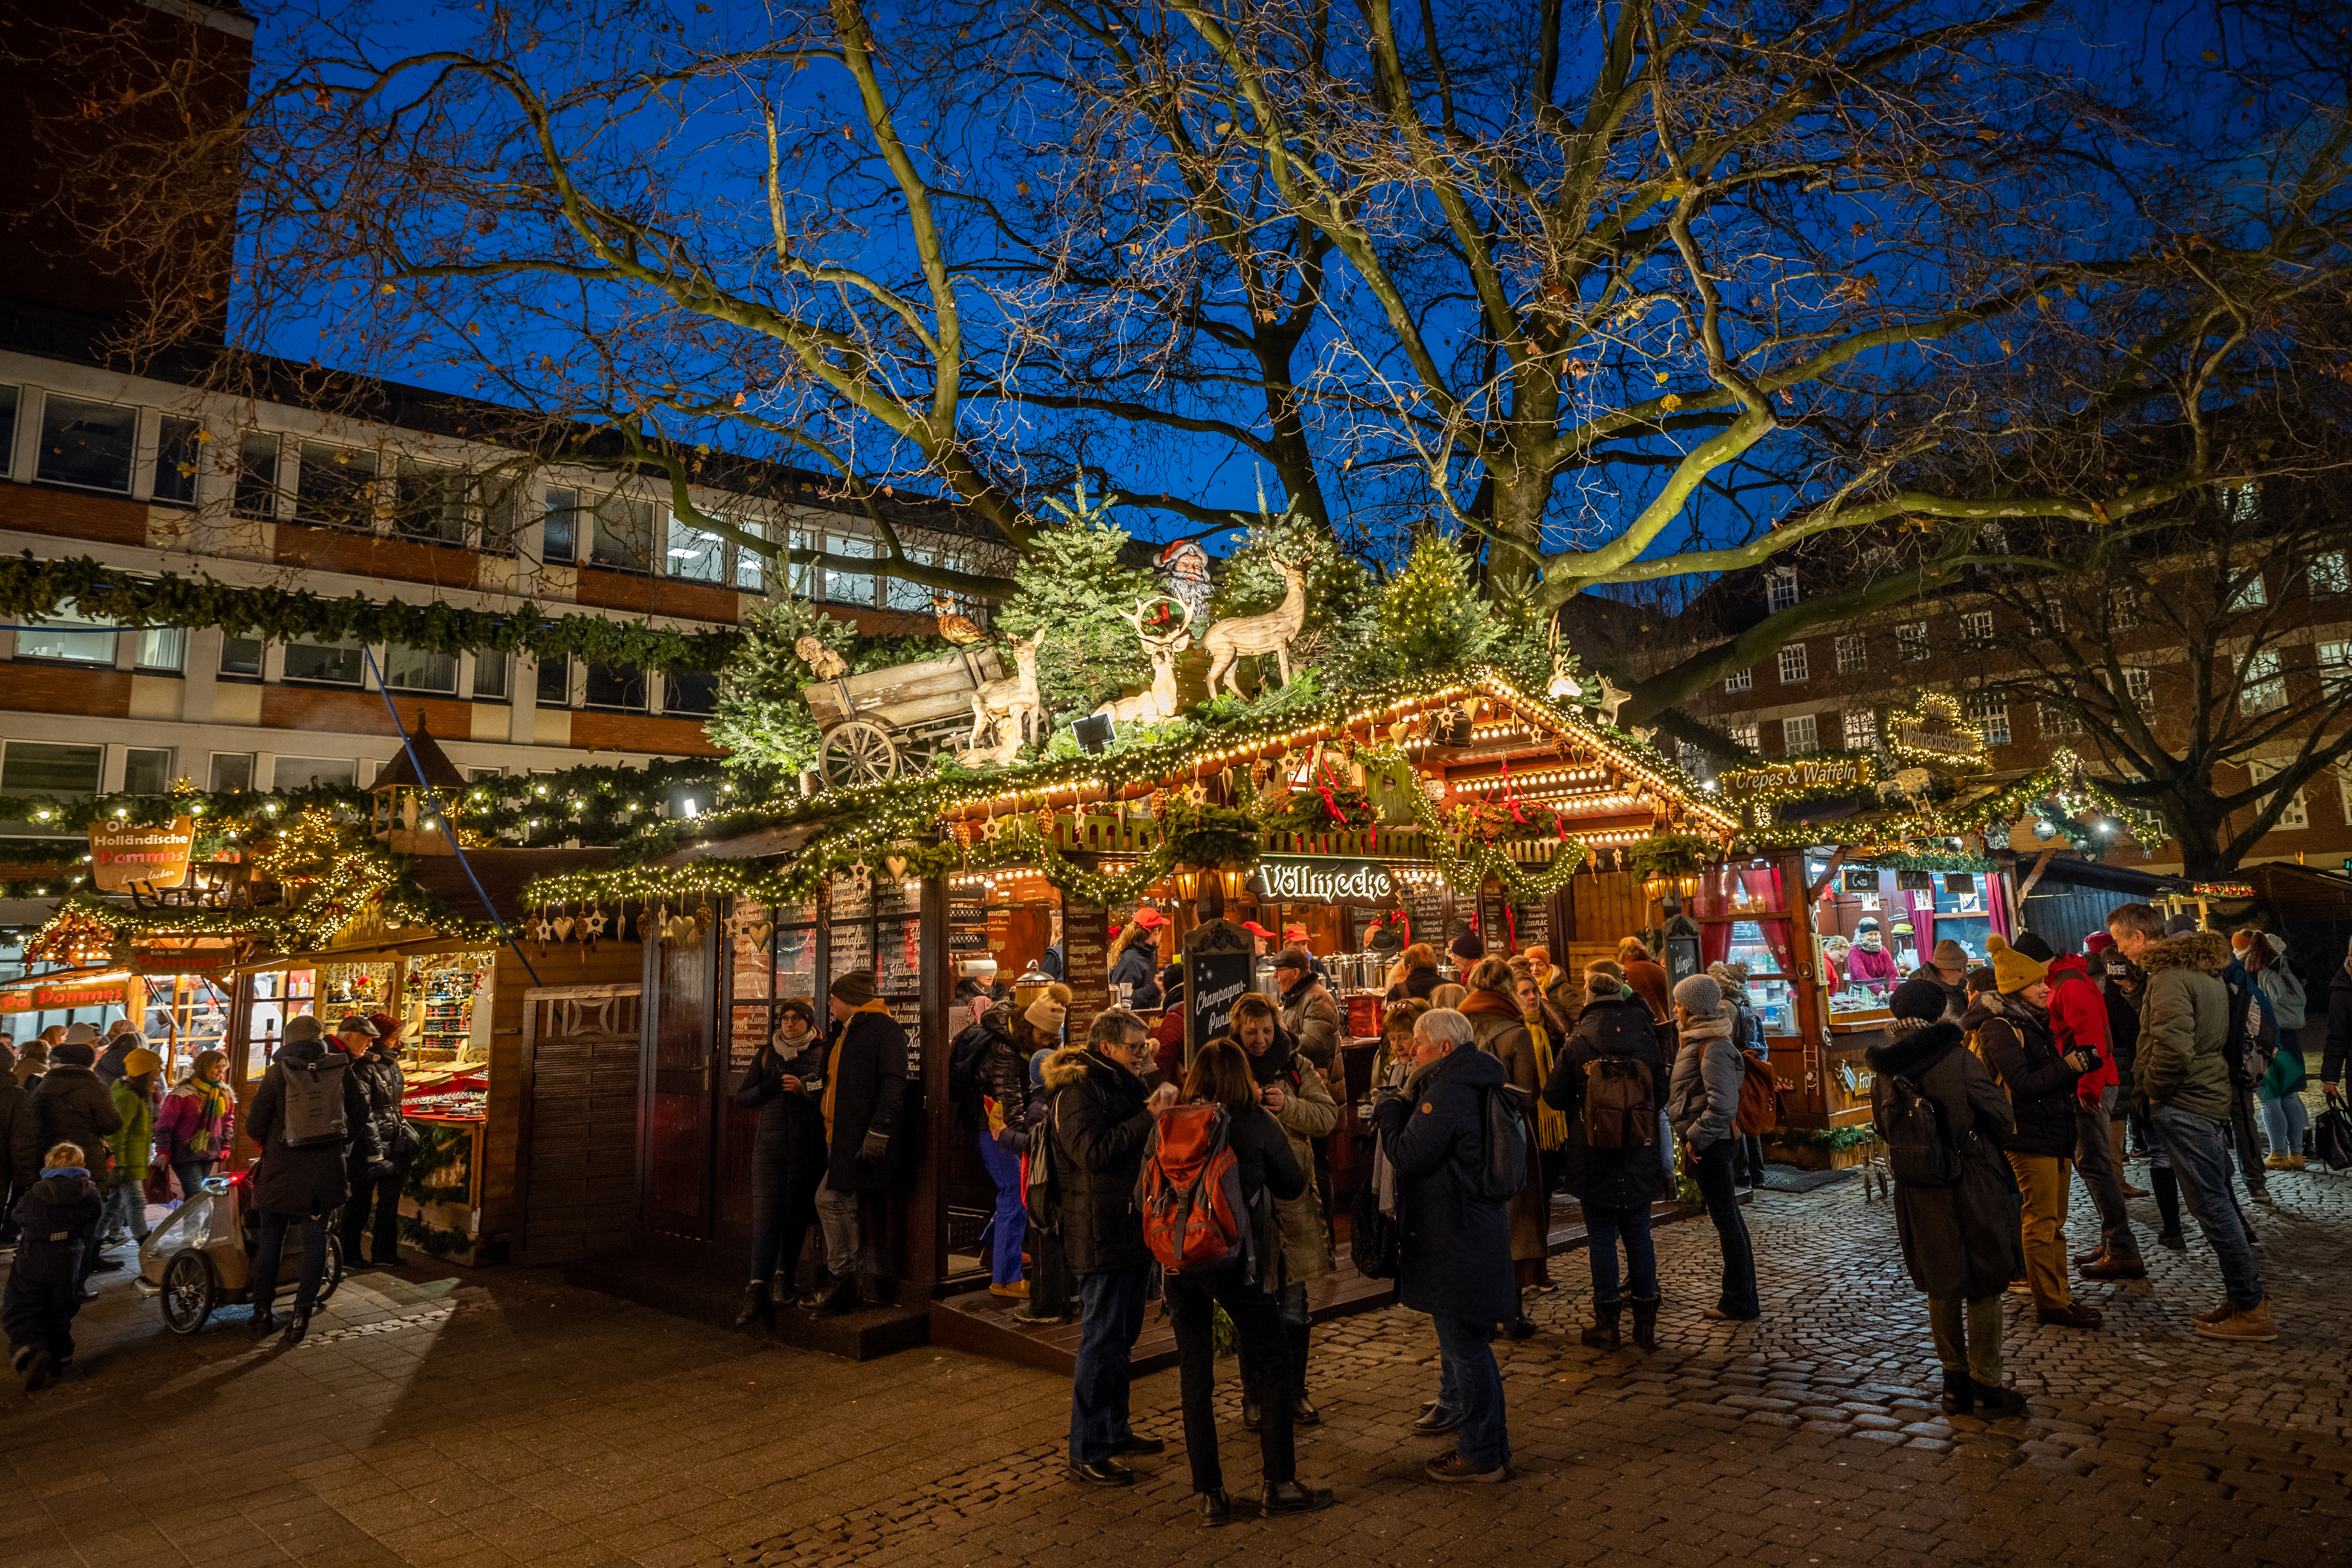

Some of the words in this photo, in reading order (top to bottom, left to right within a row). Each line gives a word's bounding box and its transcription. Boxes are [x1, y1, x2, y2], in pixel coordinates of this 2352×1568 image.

[1736, 772, 1783, 793] Crepes
[1788, 767, 1798, 785] &
[1804, 763, 1857, 783] Waffeln
[94, 834, 188, 846] Holländische
[99, 851, 184, 864] Pommes
[1260, 864, 1391, 904] Völlmecke
[988, 938, 1005, 953] Hugo
[137, 953, 224, 969] Pommes
[1068, 955, 1087, 966] Punsch
[38, 988, 122, 1005] Pommes
[1196, 980, 1246, 1016] Champagner-
